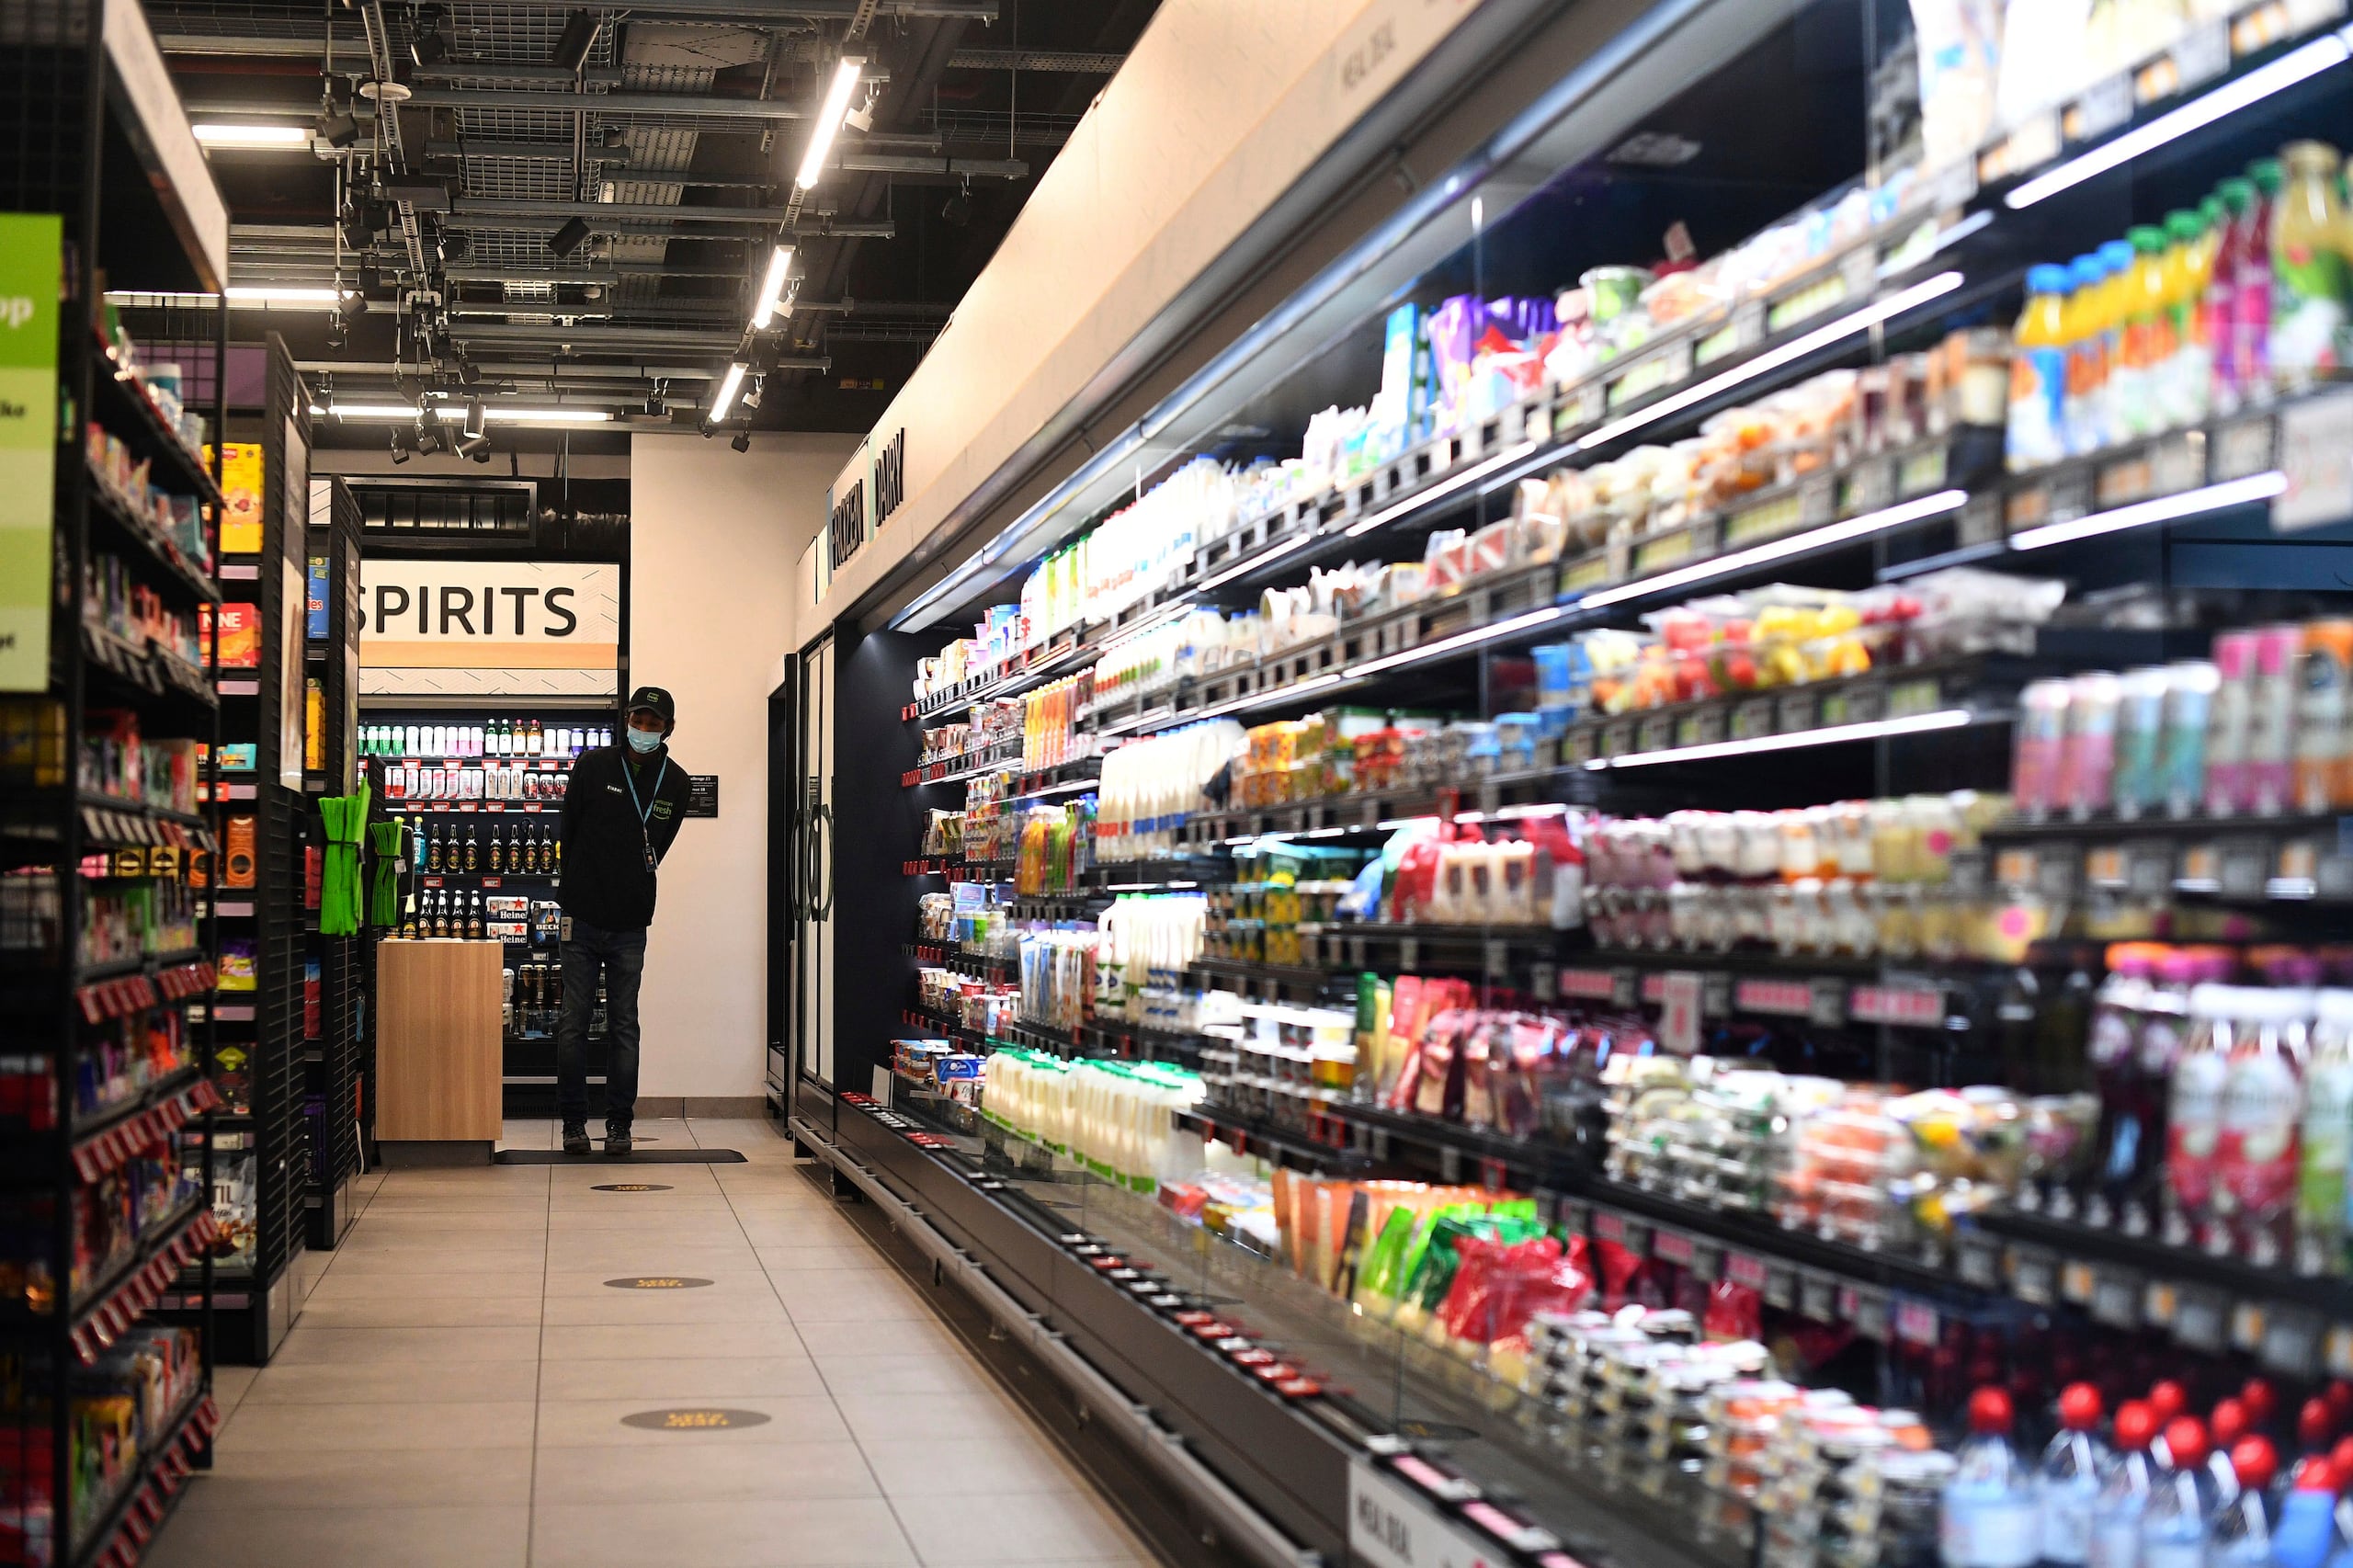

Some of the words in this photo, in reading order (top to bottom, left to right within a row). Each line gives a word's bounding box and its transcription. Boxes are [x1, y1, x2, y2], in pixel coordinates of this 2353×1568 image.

[874, 427, 905, 527] DAIRY
[832, 478, 864, 570] FROZEN
[359, 585, 577, 636] PIRITS
[500, 911, 528, 919] Heine
[501, 935, 528, 943] Heine
